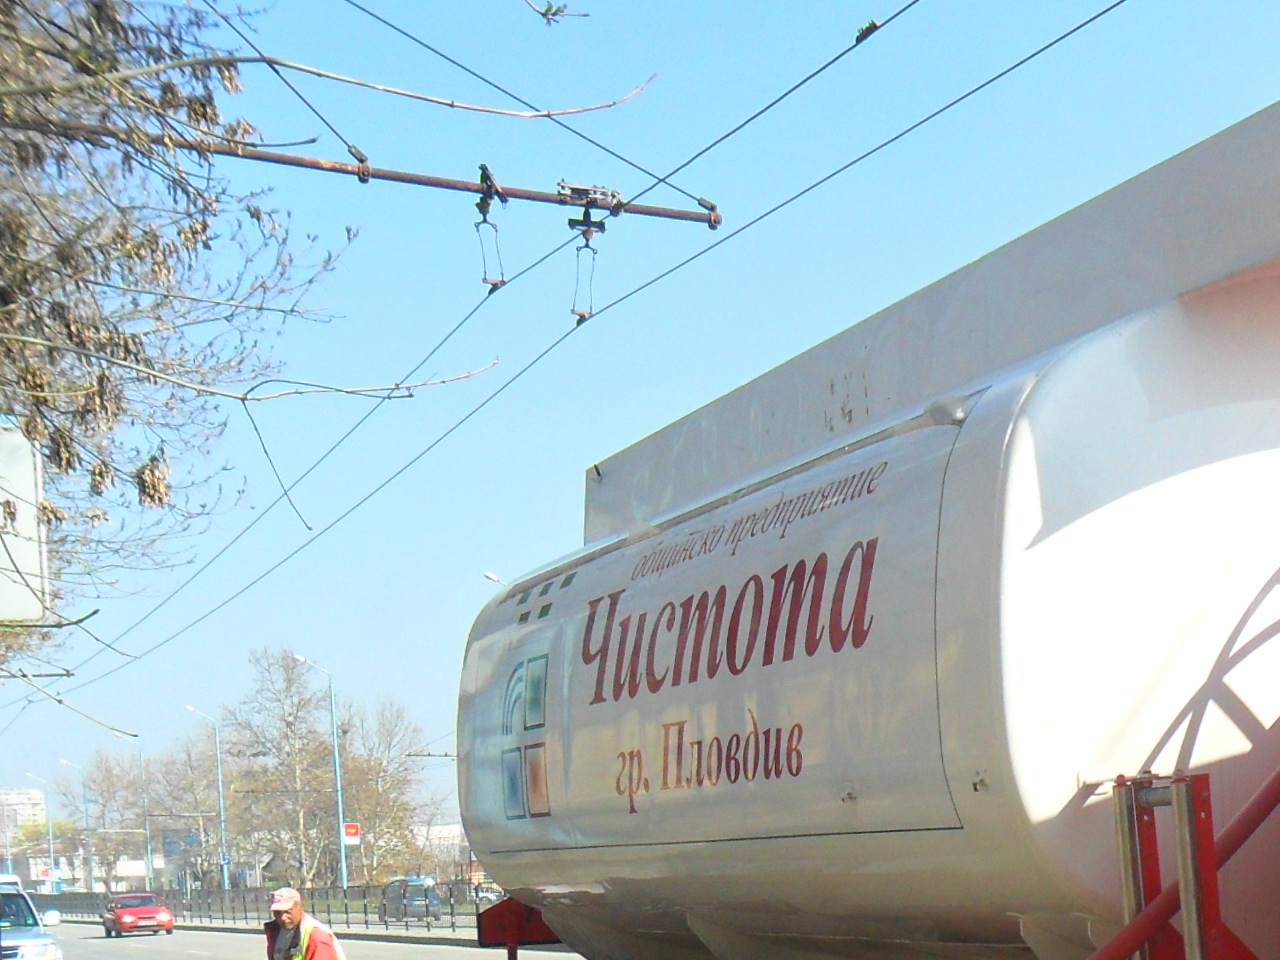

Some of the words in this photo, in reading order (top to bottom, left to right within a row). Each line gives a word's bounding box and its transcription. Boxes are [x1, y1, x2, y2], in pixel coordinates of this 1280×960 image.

[631, 519, 726, 581] общинско
[725, 460, 888, 556] предприятие
[581, 536, 879, 706] Чистота
[615, 748, 650, 814] гр.
[659, 707, 804, 791] Пловдив
